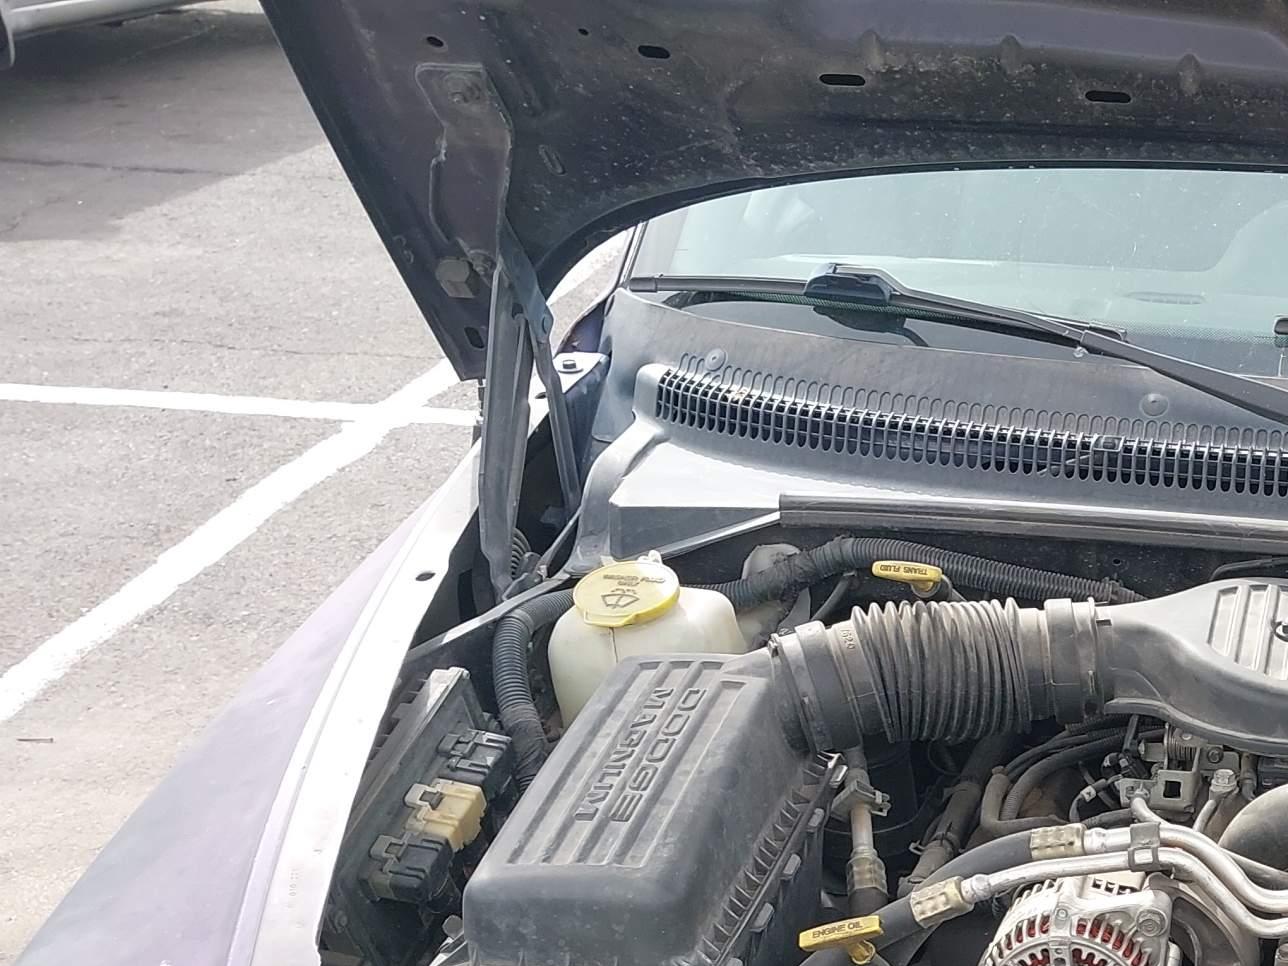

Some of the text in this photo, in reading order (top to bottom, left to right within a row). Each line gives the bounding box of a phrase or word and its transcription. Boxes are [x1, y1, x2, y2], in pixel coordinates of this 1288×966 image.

[879, 564, 929, 576] TRANS FLUID
[574, 688, 674, 821] MAGNUM
[609, 688, 707, 822] DODGE
[811, 921, 863, 939] ENGINE OIL
